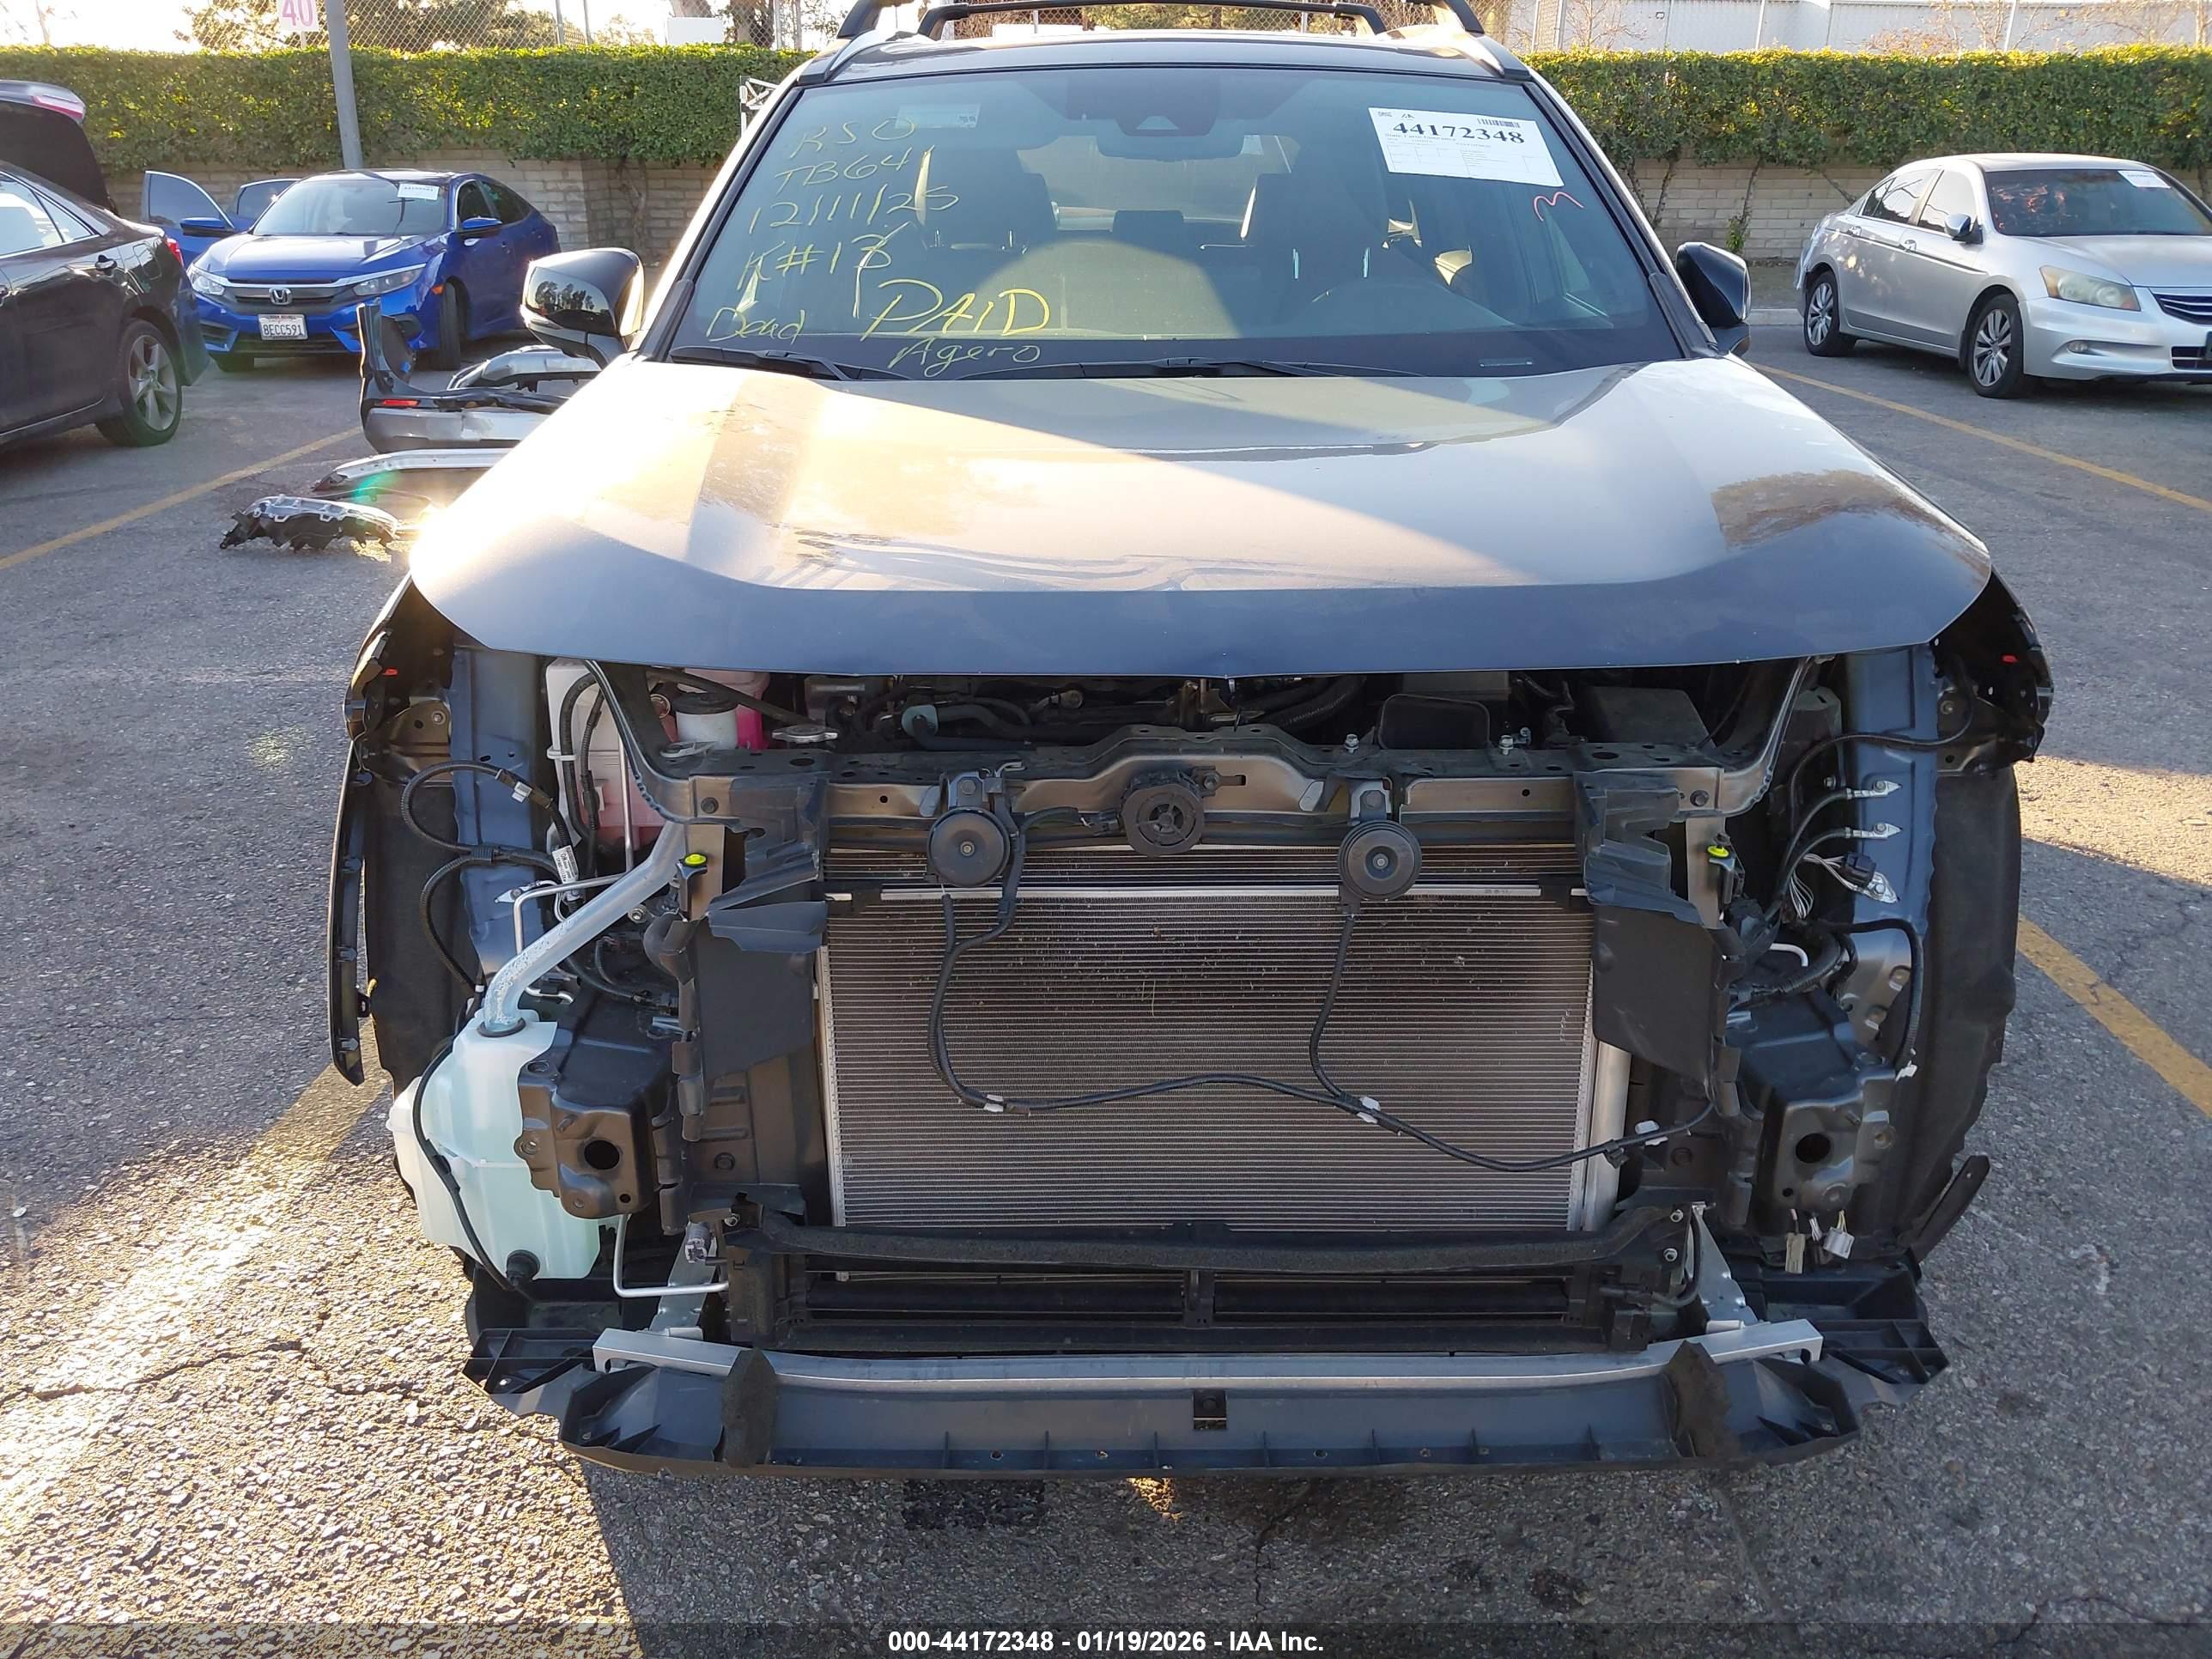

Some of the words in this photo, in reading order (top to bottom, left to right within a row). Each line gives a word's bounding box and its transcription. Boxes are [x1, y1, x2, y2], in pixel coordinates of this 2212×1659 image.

[283, 0, 313, 27] 40
[1393, 122, 1525, 144] 44172348
[775, 147, 913, 195] TB64
[748, 183, 960, 234] 12/11/25
[263, 324, 303, 336] 8ECC591
[860, 278, 1050, 342] PAID
[887, 337, 1041, 378] Agero
